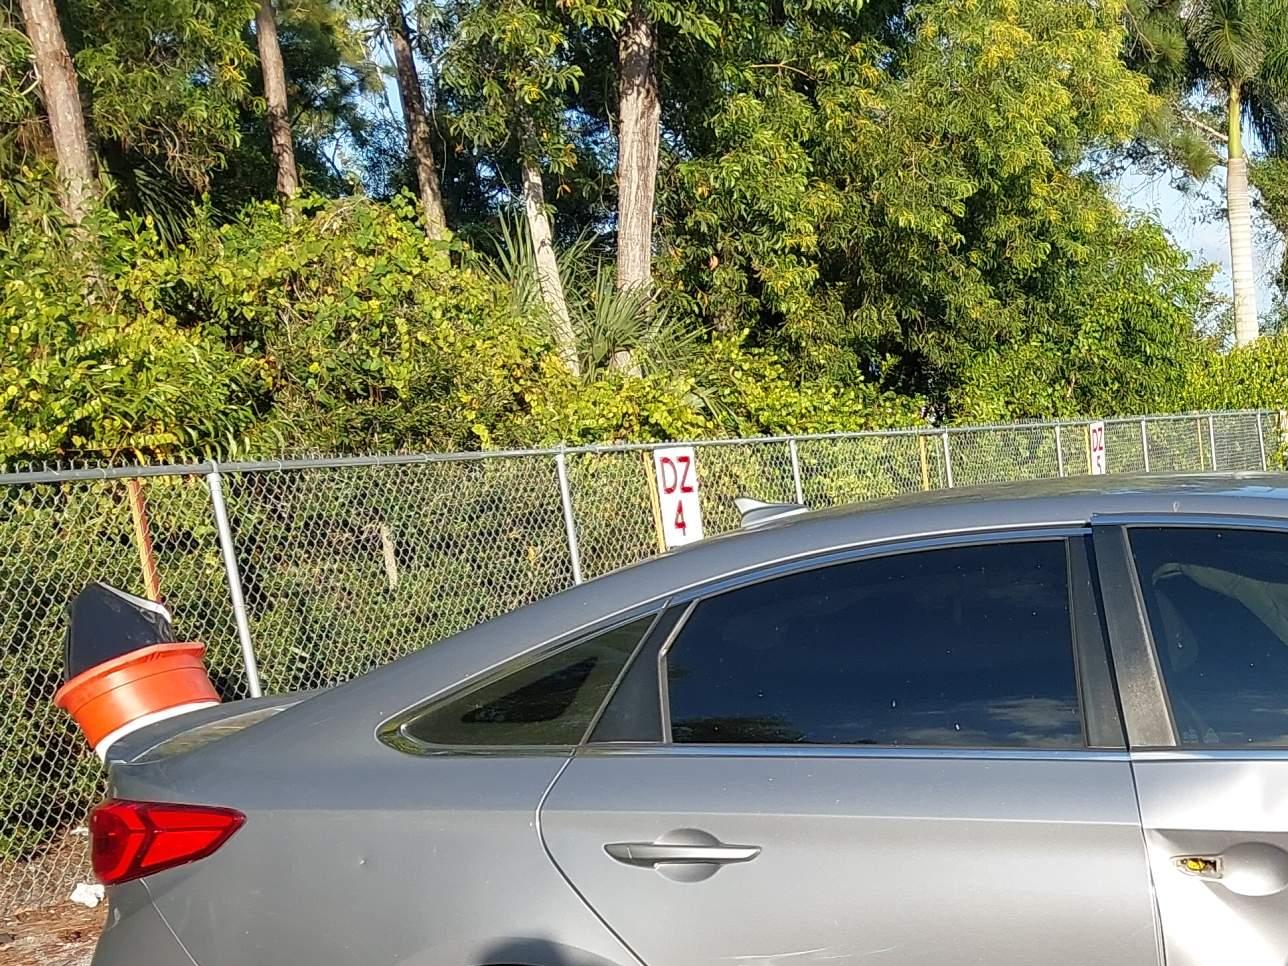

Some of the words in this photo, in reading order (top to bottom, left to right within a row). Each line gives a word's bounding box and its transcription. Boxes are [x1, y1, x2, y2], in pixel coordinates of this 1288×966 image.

[1092, 427, 1103, 452] DZ
[660, 456, 694, 494] DZ
[674, 499, 686, 536] 4
